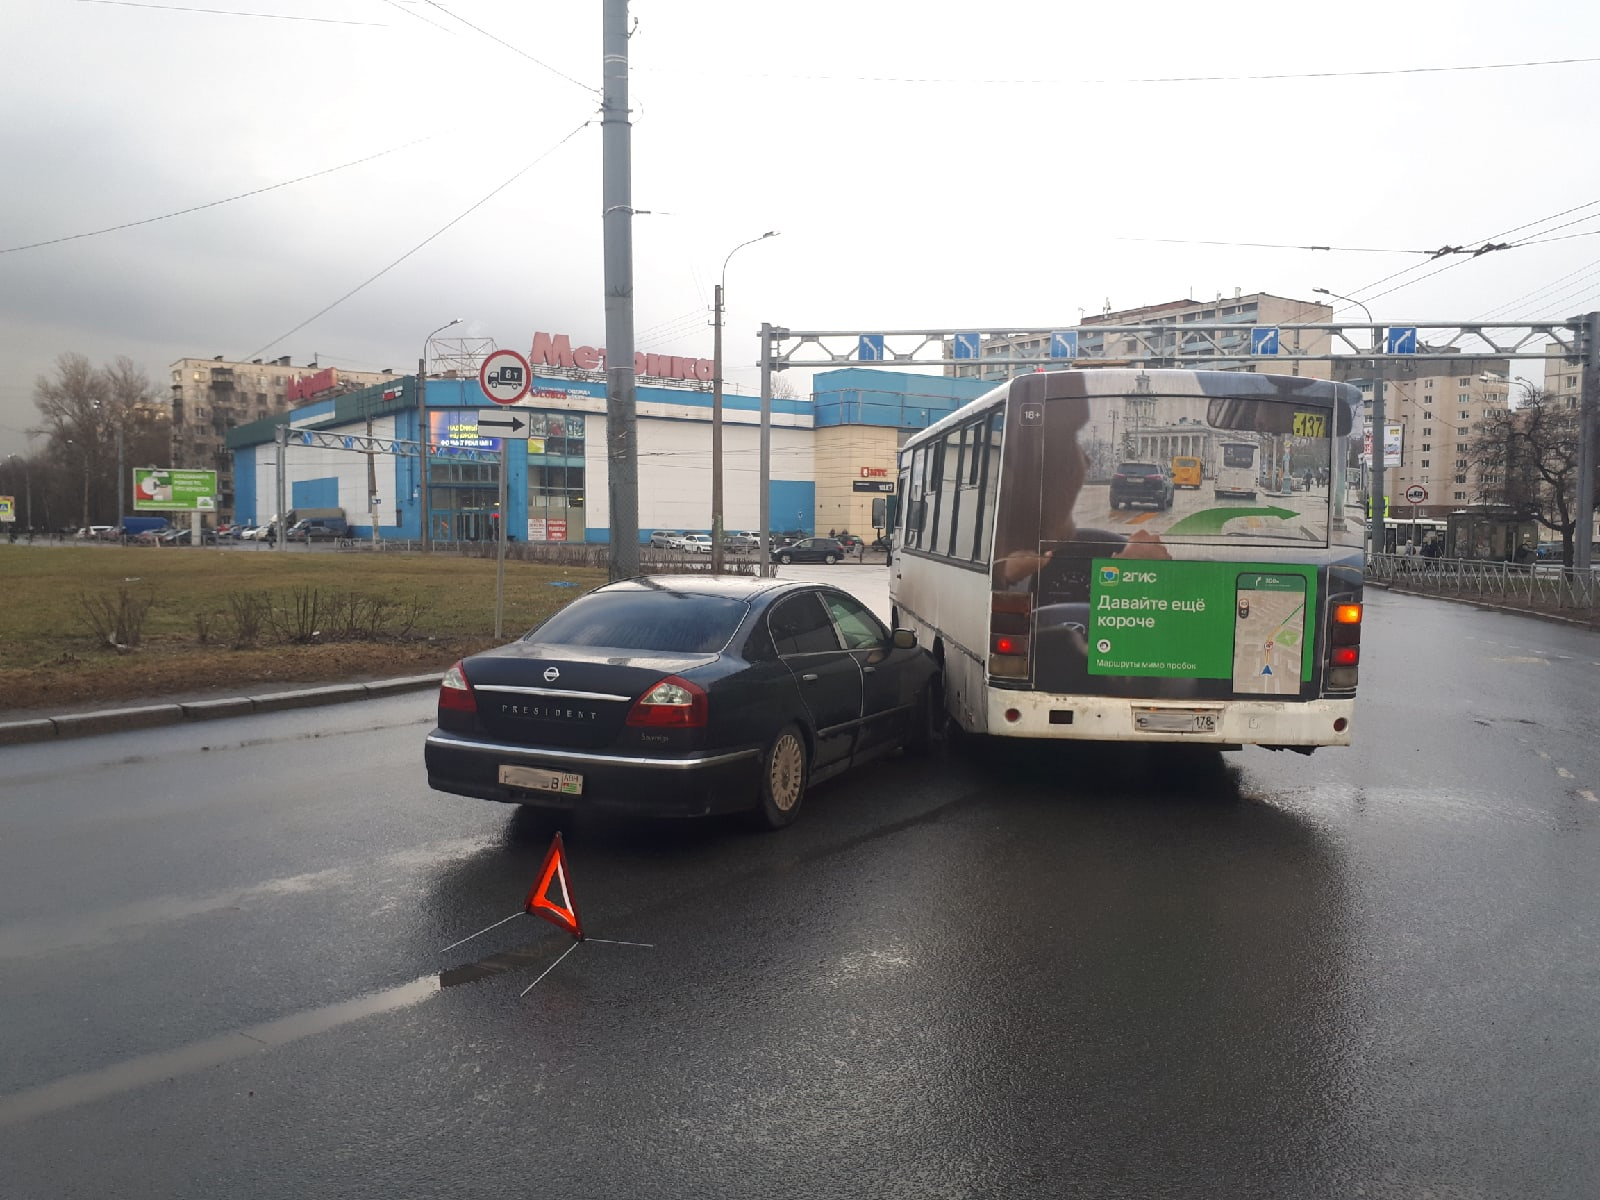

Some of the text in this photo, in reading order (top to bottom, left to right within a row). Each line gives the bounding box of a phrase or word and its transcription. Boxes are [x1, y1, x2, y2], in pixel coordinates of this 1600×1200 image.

[505, 369, 511, 379] 8
[1025, 410, 1041, 420] 18+
[1122, 571, 1157, 583] 2ГИС
[1097, 594, 1206, 613] Давайте ещё
[1097, 616, 1155, 629] короче
[1096, 659, 1197, 671] Маршруты мимо пробок
[502, 704, 597, 720] PRESIDENT
[1194, 716, 1211, 726] 178
